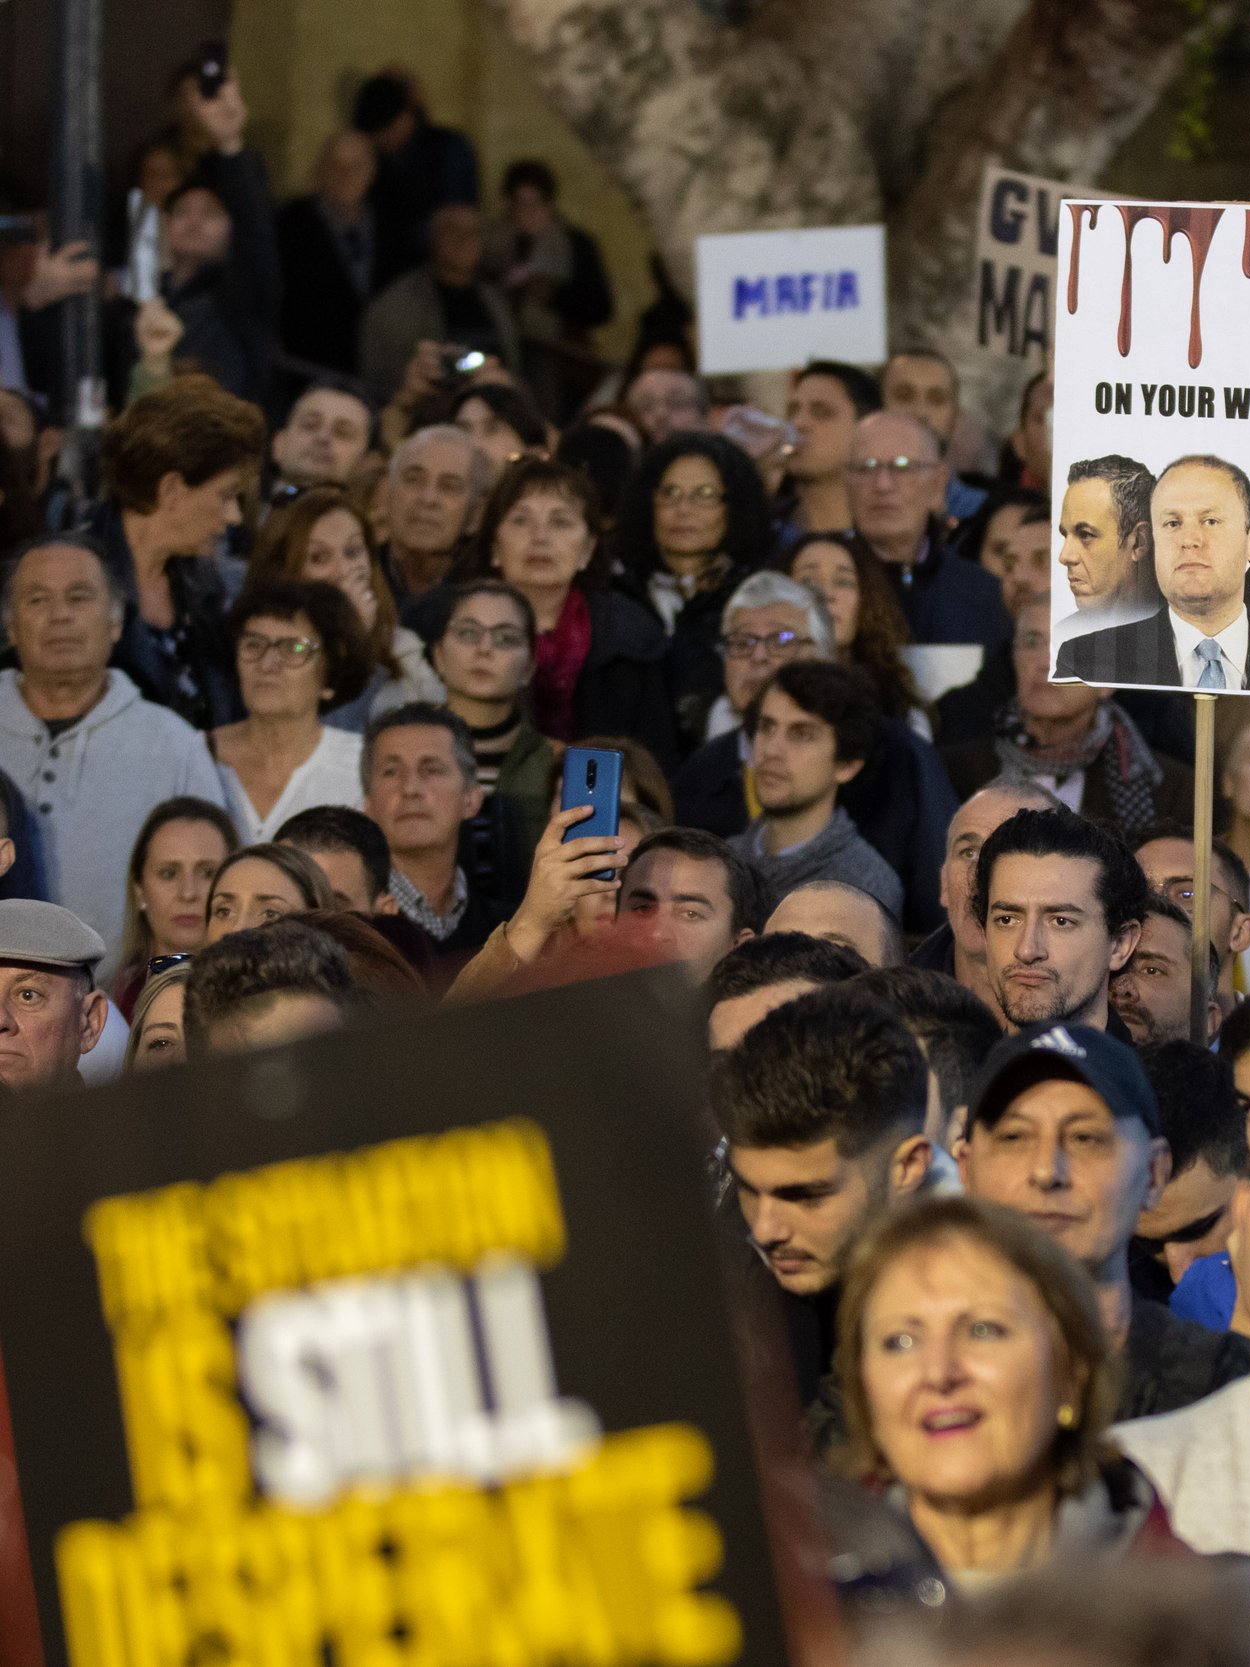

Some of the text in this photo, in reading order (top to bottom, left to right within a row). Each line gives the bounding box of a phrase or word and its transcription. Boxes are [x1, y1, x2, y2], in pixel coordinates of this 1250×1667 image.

[733, 270, 859, 321] MAFIA
[1095, 381, 1132, 415] ON
[1141, 383, 1215, 418] YOUR
[238, 1247, 602, 1516] STILL
